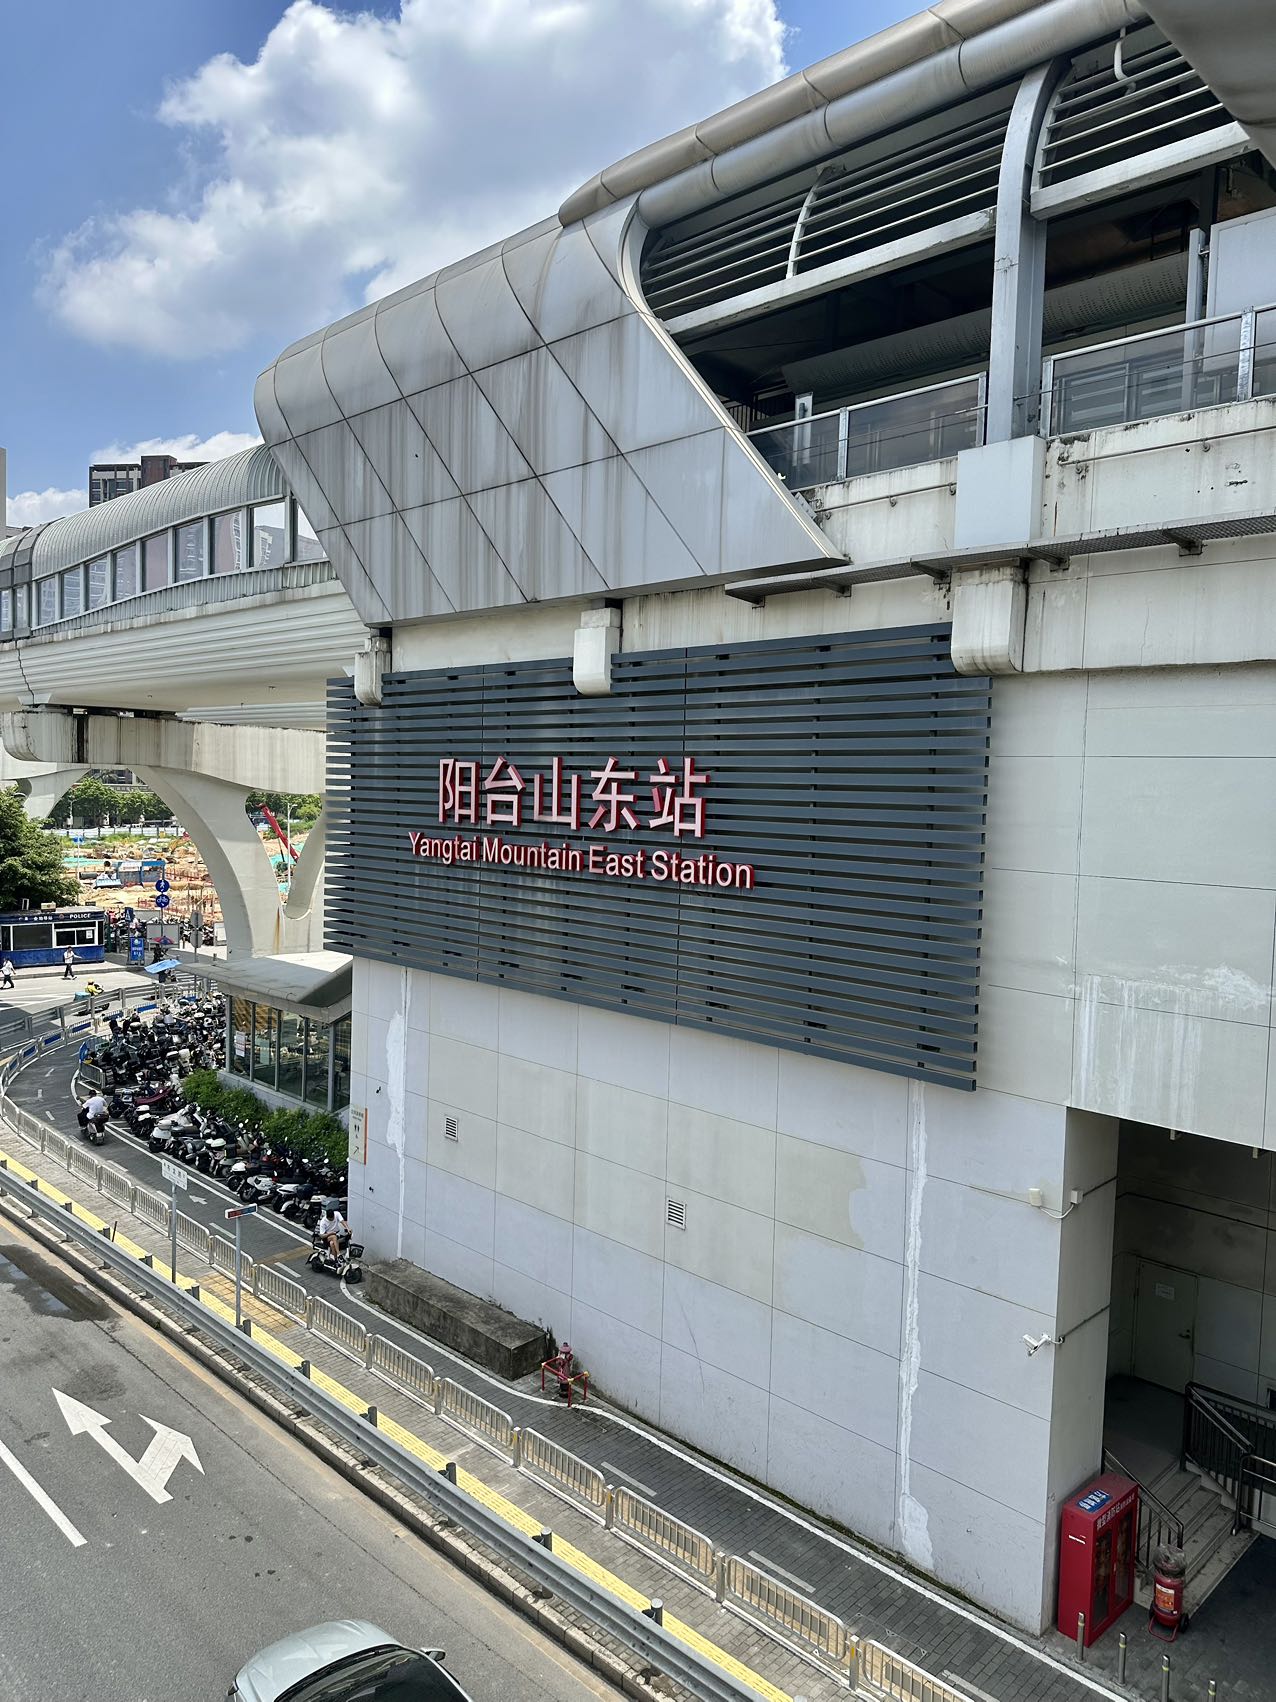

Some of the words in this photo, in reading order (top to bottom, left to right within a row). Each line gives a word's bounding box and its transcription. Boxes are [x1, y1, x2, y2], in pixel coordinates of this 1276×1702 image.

[438, 755, 711, 839] 阳台山东站
[408, 831, 480, 865] Yangtai
[482, 836, 585, 872] Mountain
[588, 844, 647, 879] East
[650, 850, 755, 889] Station
